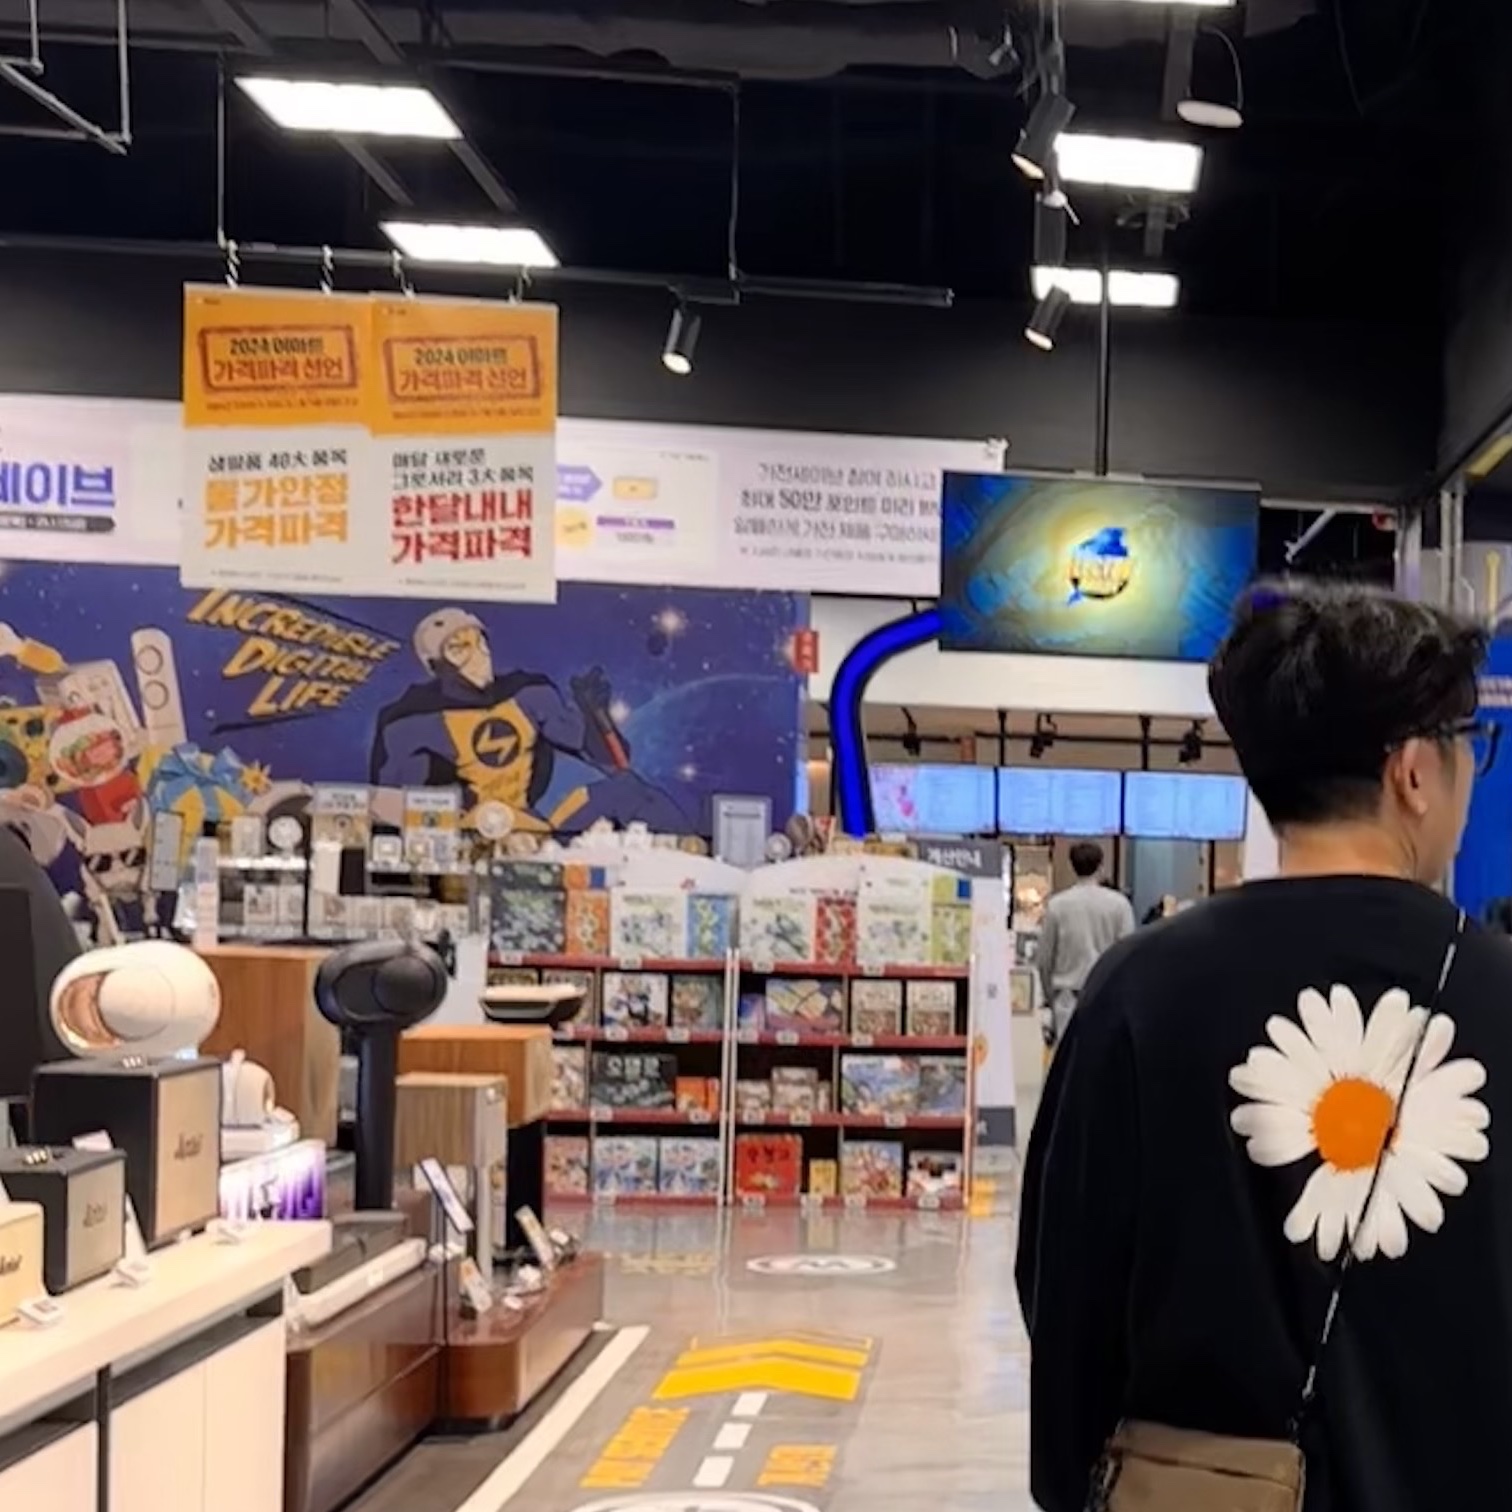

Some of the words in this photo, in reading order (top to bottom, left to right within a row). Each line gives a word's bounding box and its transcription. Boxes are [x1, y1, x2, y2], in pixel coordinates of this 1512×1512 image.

[230, 338, 271, 356] 2024
[414, 348, 456, 365] 2024
[392, 488, 532, 527] 한달내내
[205, 513, 348, 548] 가격파격
[392, 526, 532, 563] 가격파격
[221, 635, 374, 684] DIGITAL
[247, 675, 351, 718] LIFE
